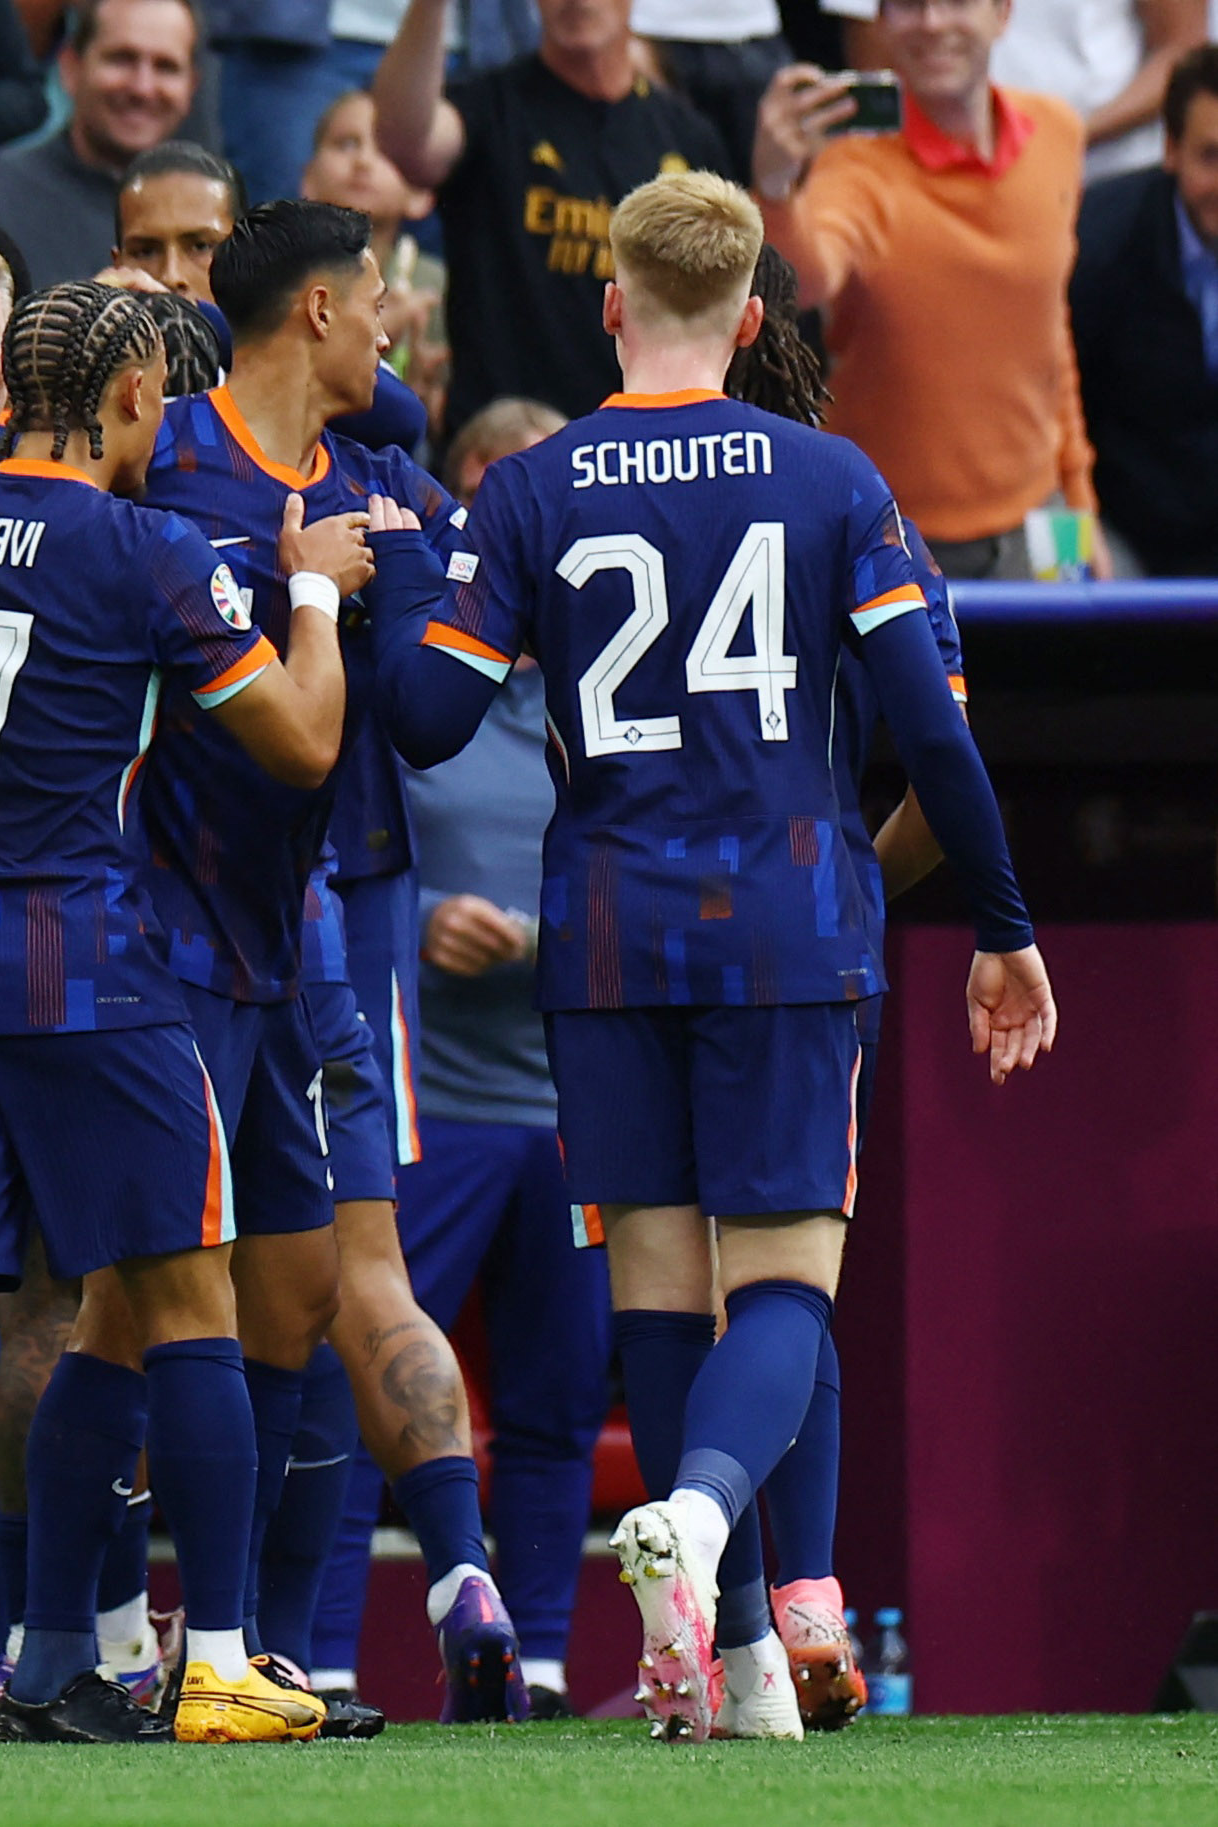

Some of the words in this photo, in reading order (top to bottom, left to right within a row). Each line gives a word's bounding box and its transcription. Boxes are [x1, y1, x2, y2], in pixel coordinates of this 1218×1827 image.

[571, 431, 773, 488] SCHOUTEN
[555, 521, 798, 758] 24
[305, 1067, 330, 1157] 1
